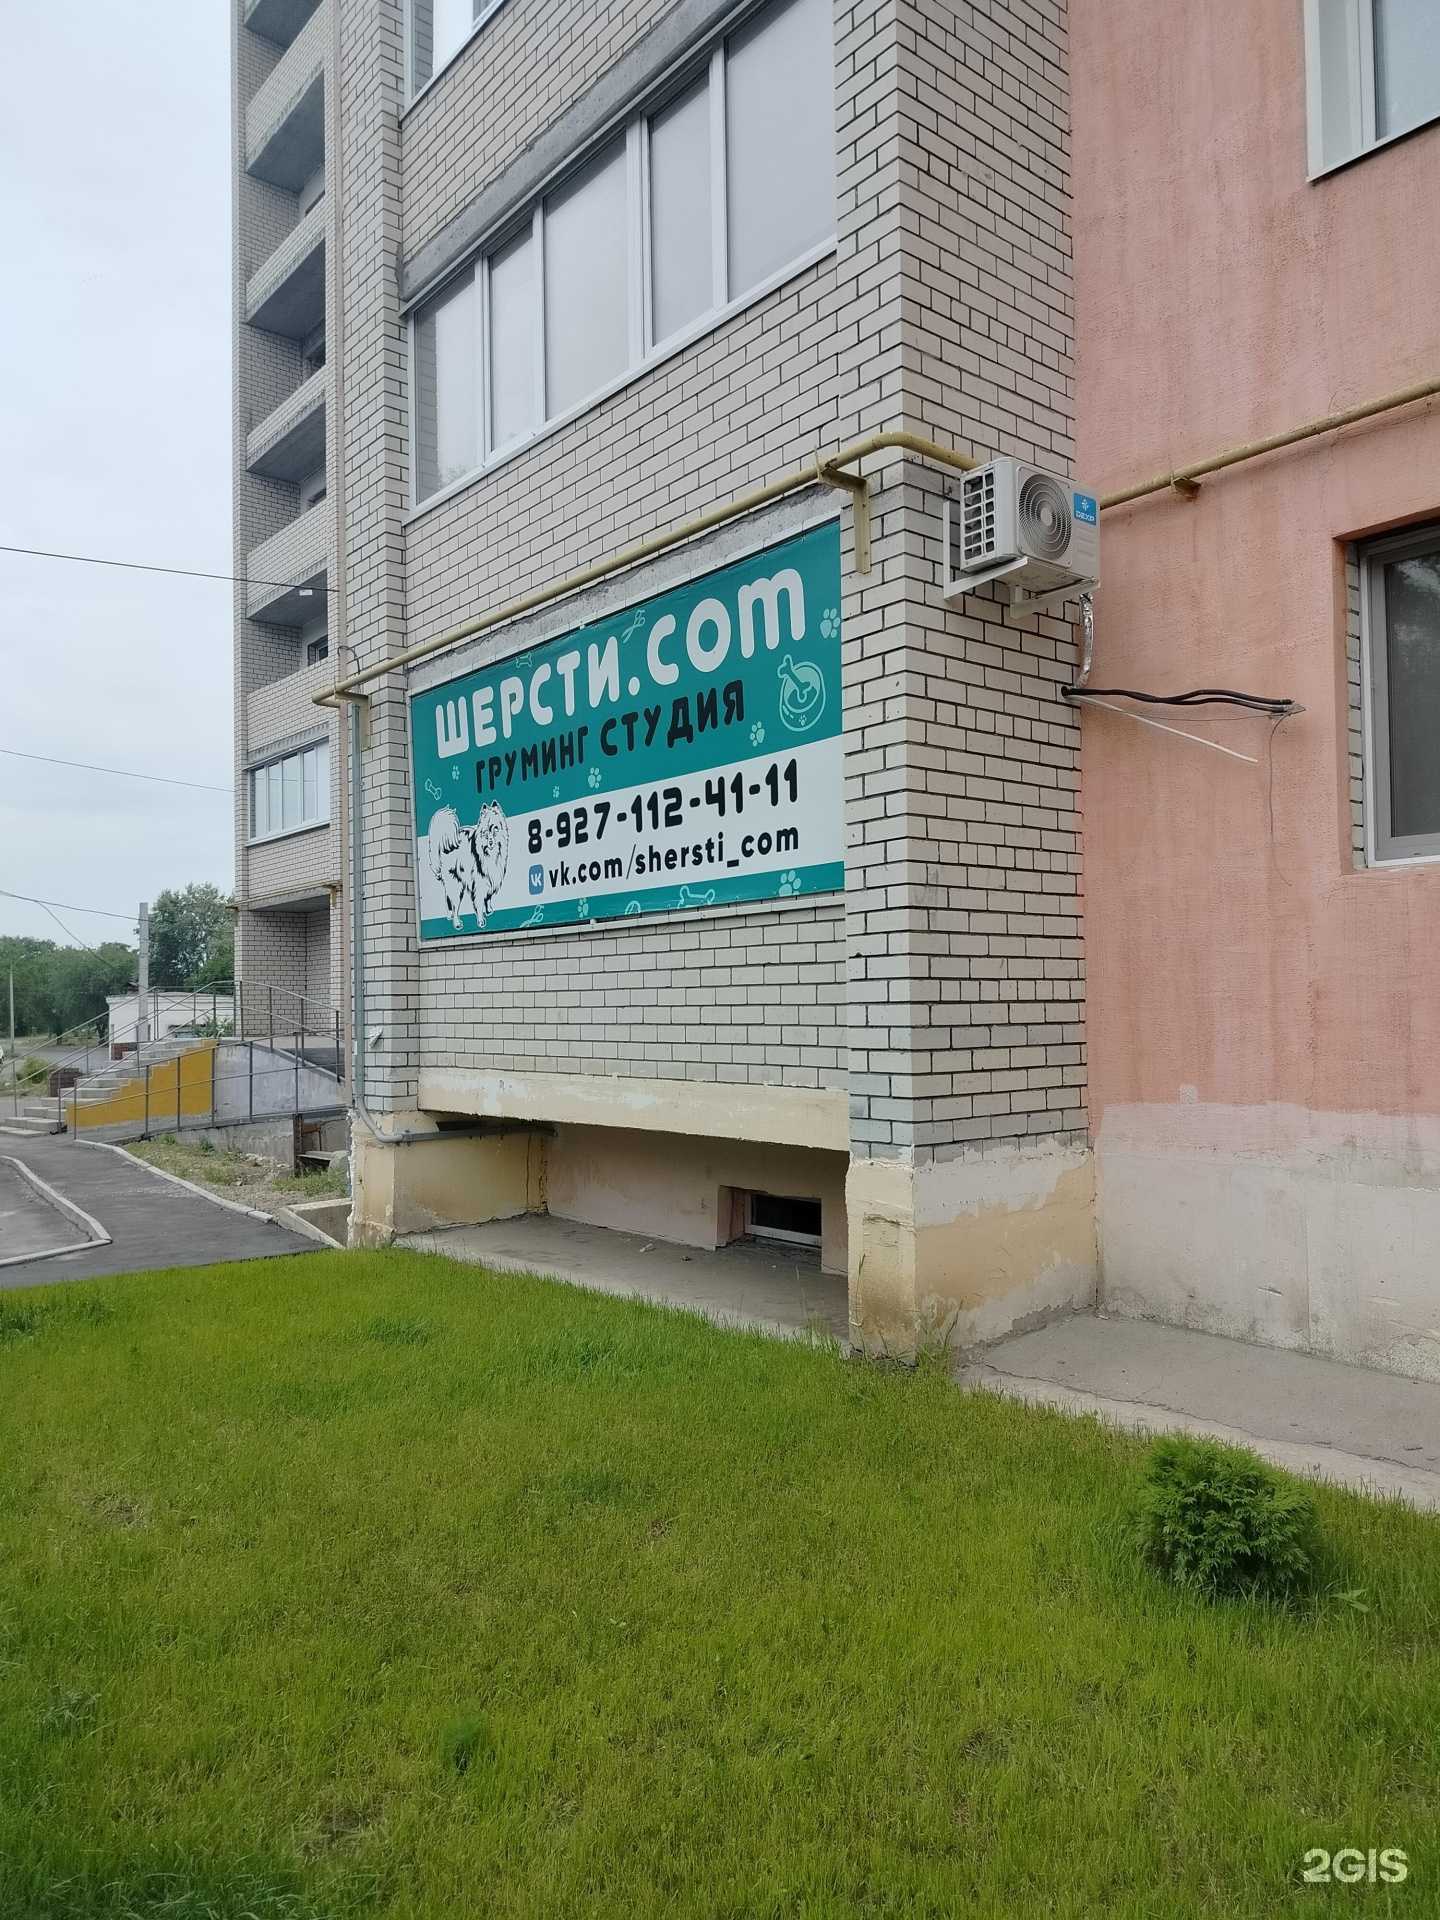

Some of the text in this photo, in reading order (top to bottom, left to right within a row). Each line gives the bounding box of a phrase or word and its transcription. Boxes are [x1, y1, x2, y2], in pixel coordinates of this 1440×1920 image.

[475, 679, 745, 793] ГРУМИНГ СТУДИЯ
[528, 758, 798, 854] 8-927-112-41-11
[548, 826, 799, 888] vk.com/shersti_com
